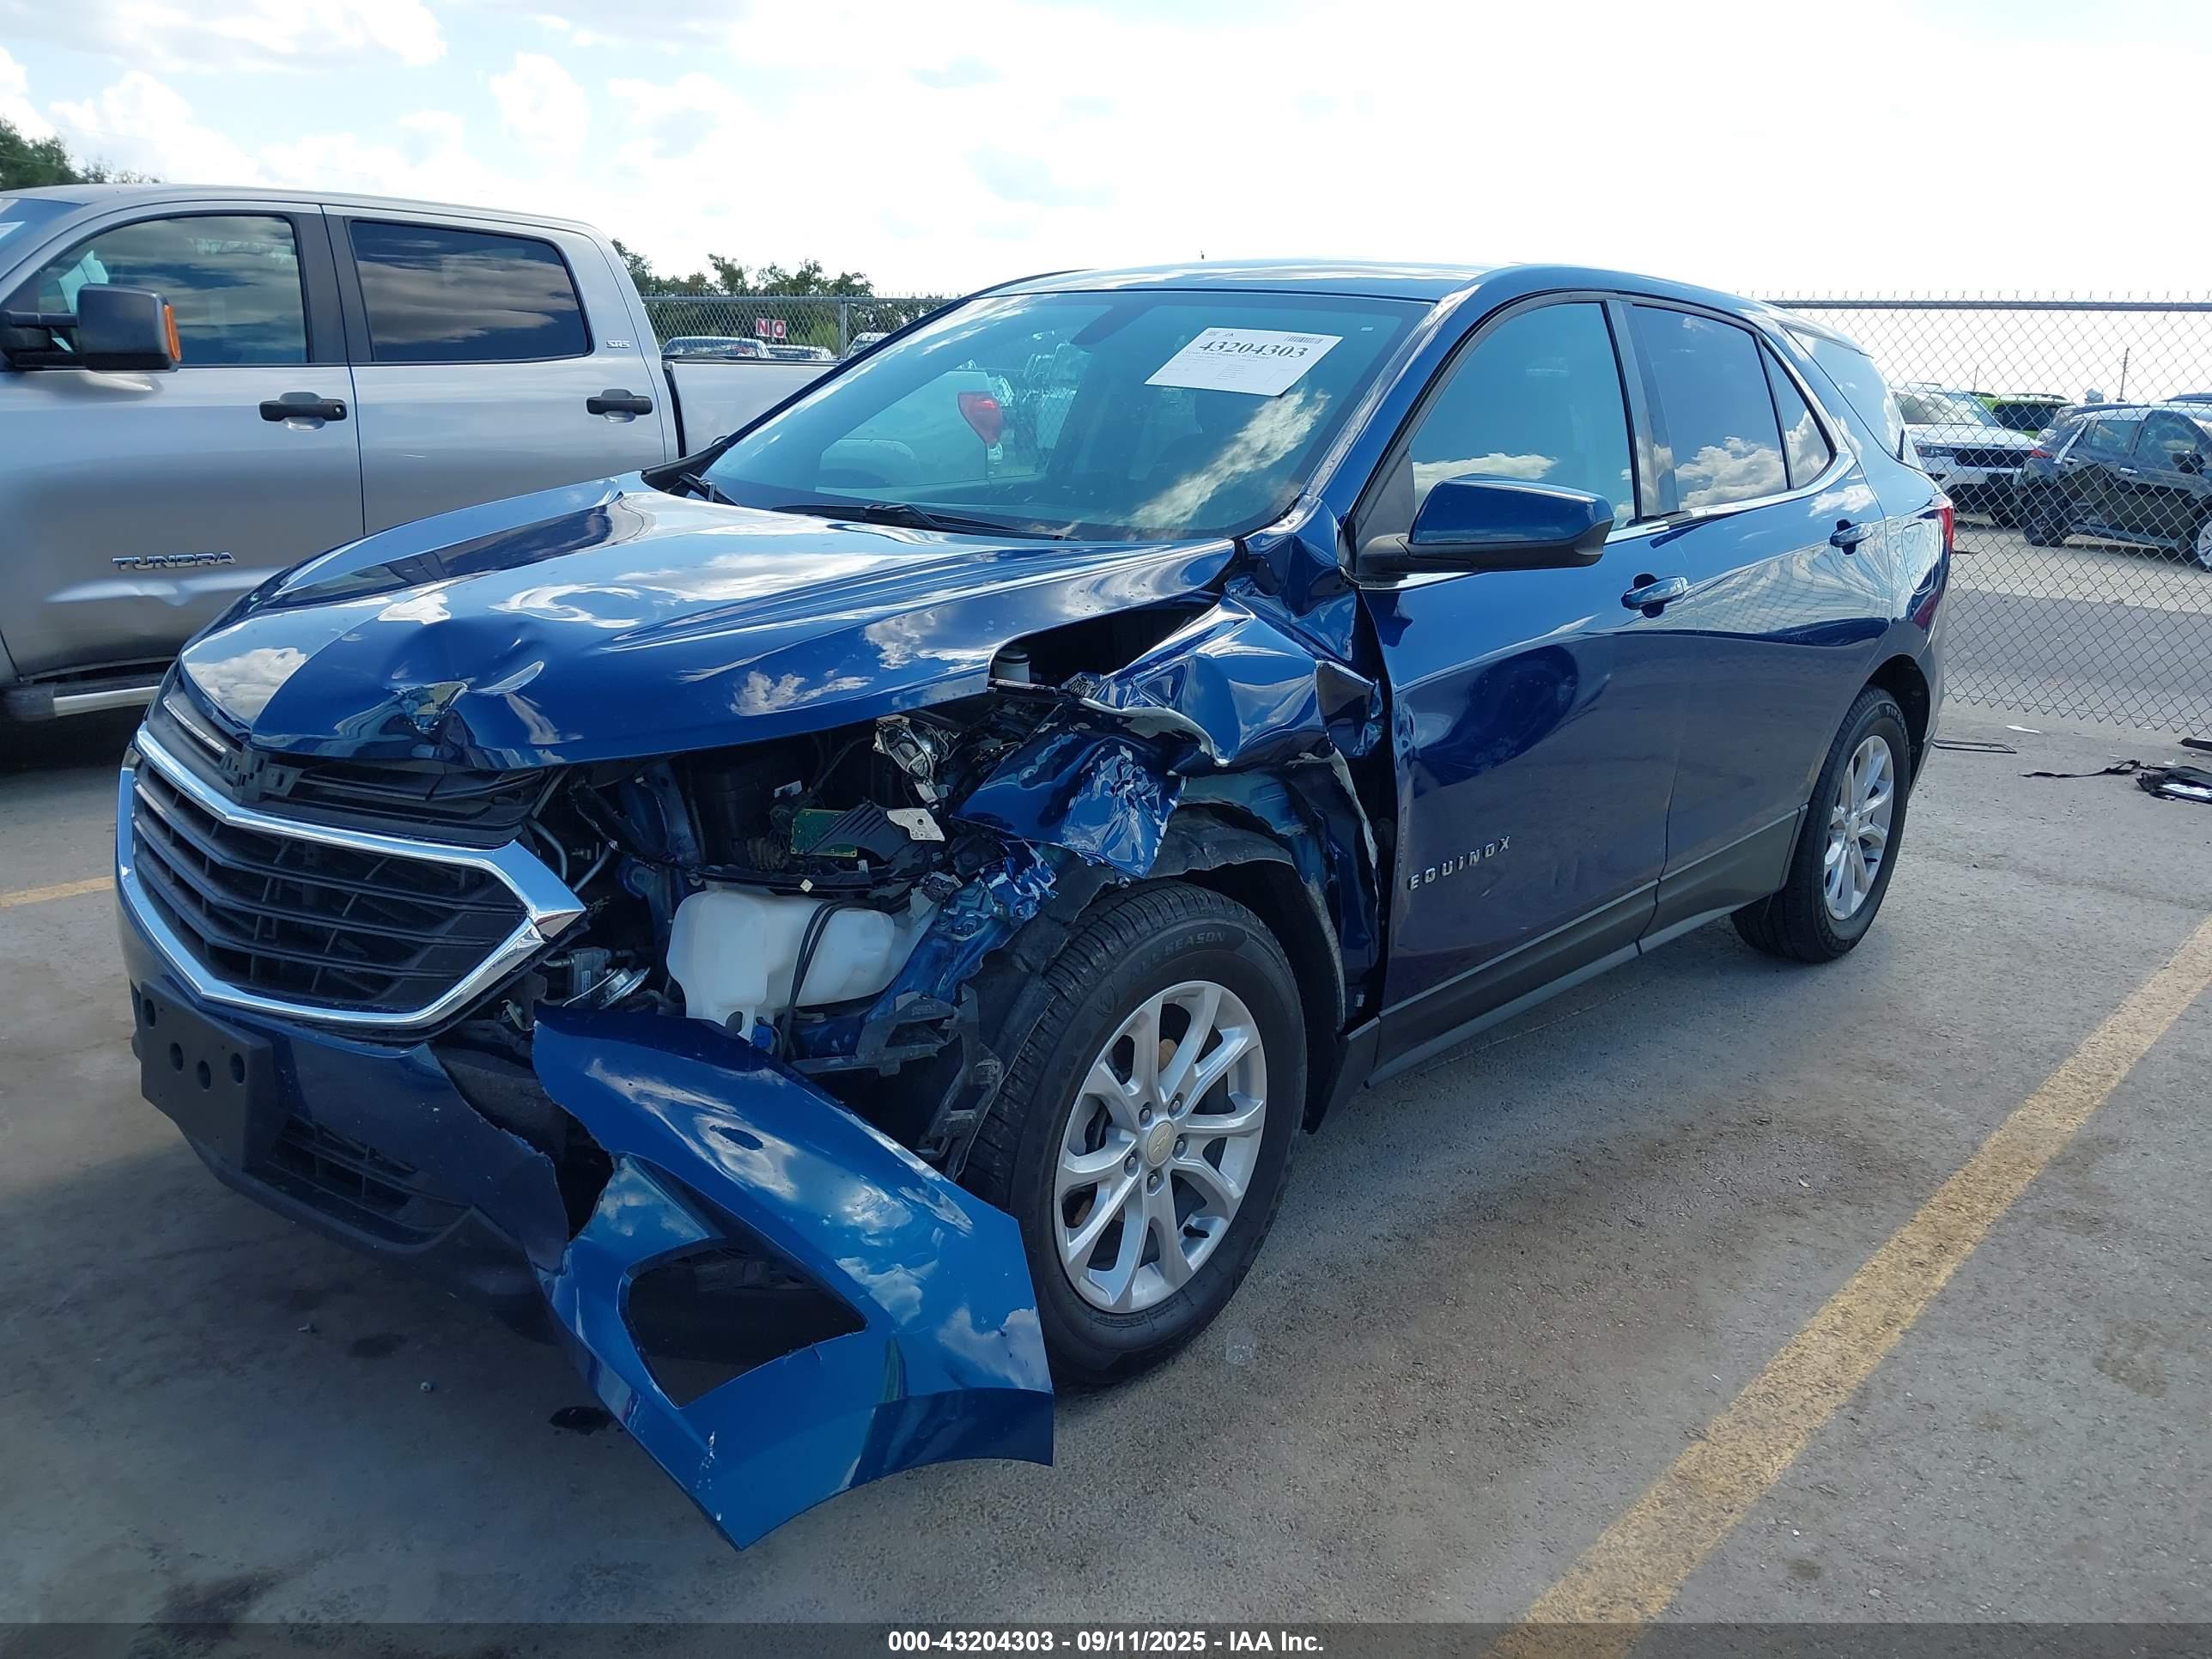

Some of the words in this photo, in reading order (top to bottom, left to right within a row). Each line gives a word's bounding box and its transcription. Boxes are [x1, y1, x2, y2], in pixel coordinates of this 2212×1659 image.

[757, 319, 786, 337] NO
[1199, 341, 1309, 357] 43204303
[112, 552, 236, 571] TUNDRA
[1408, 836, 1511, 891] EQUINOX
